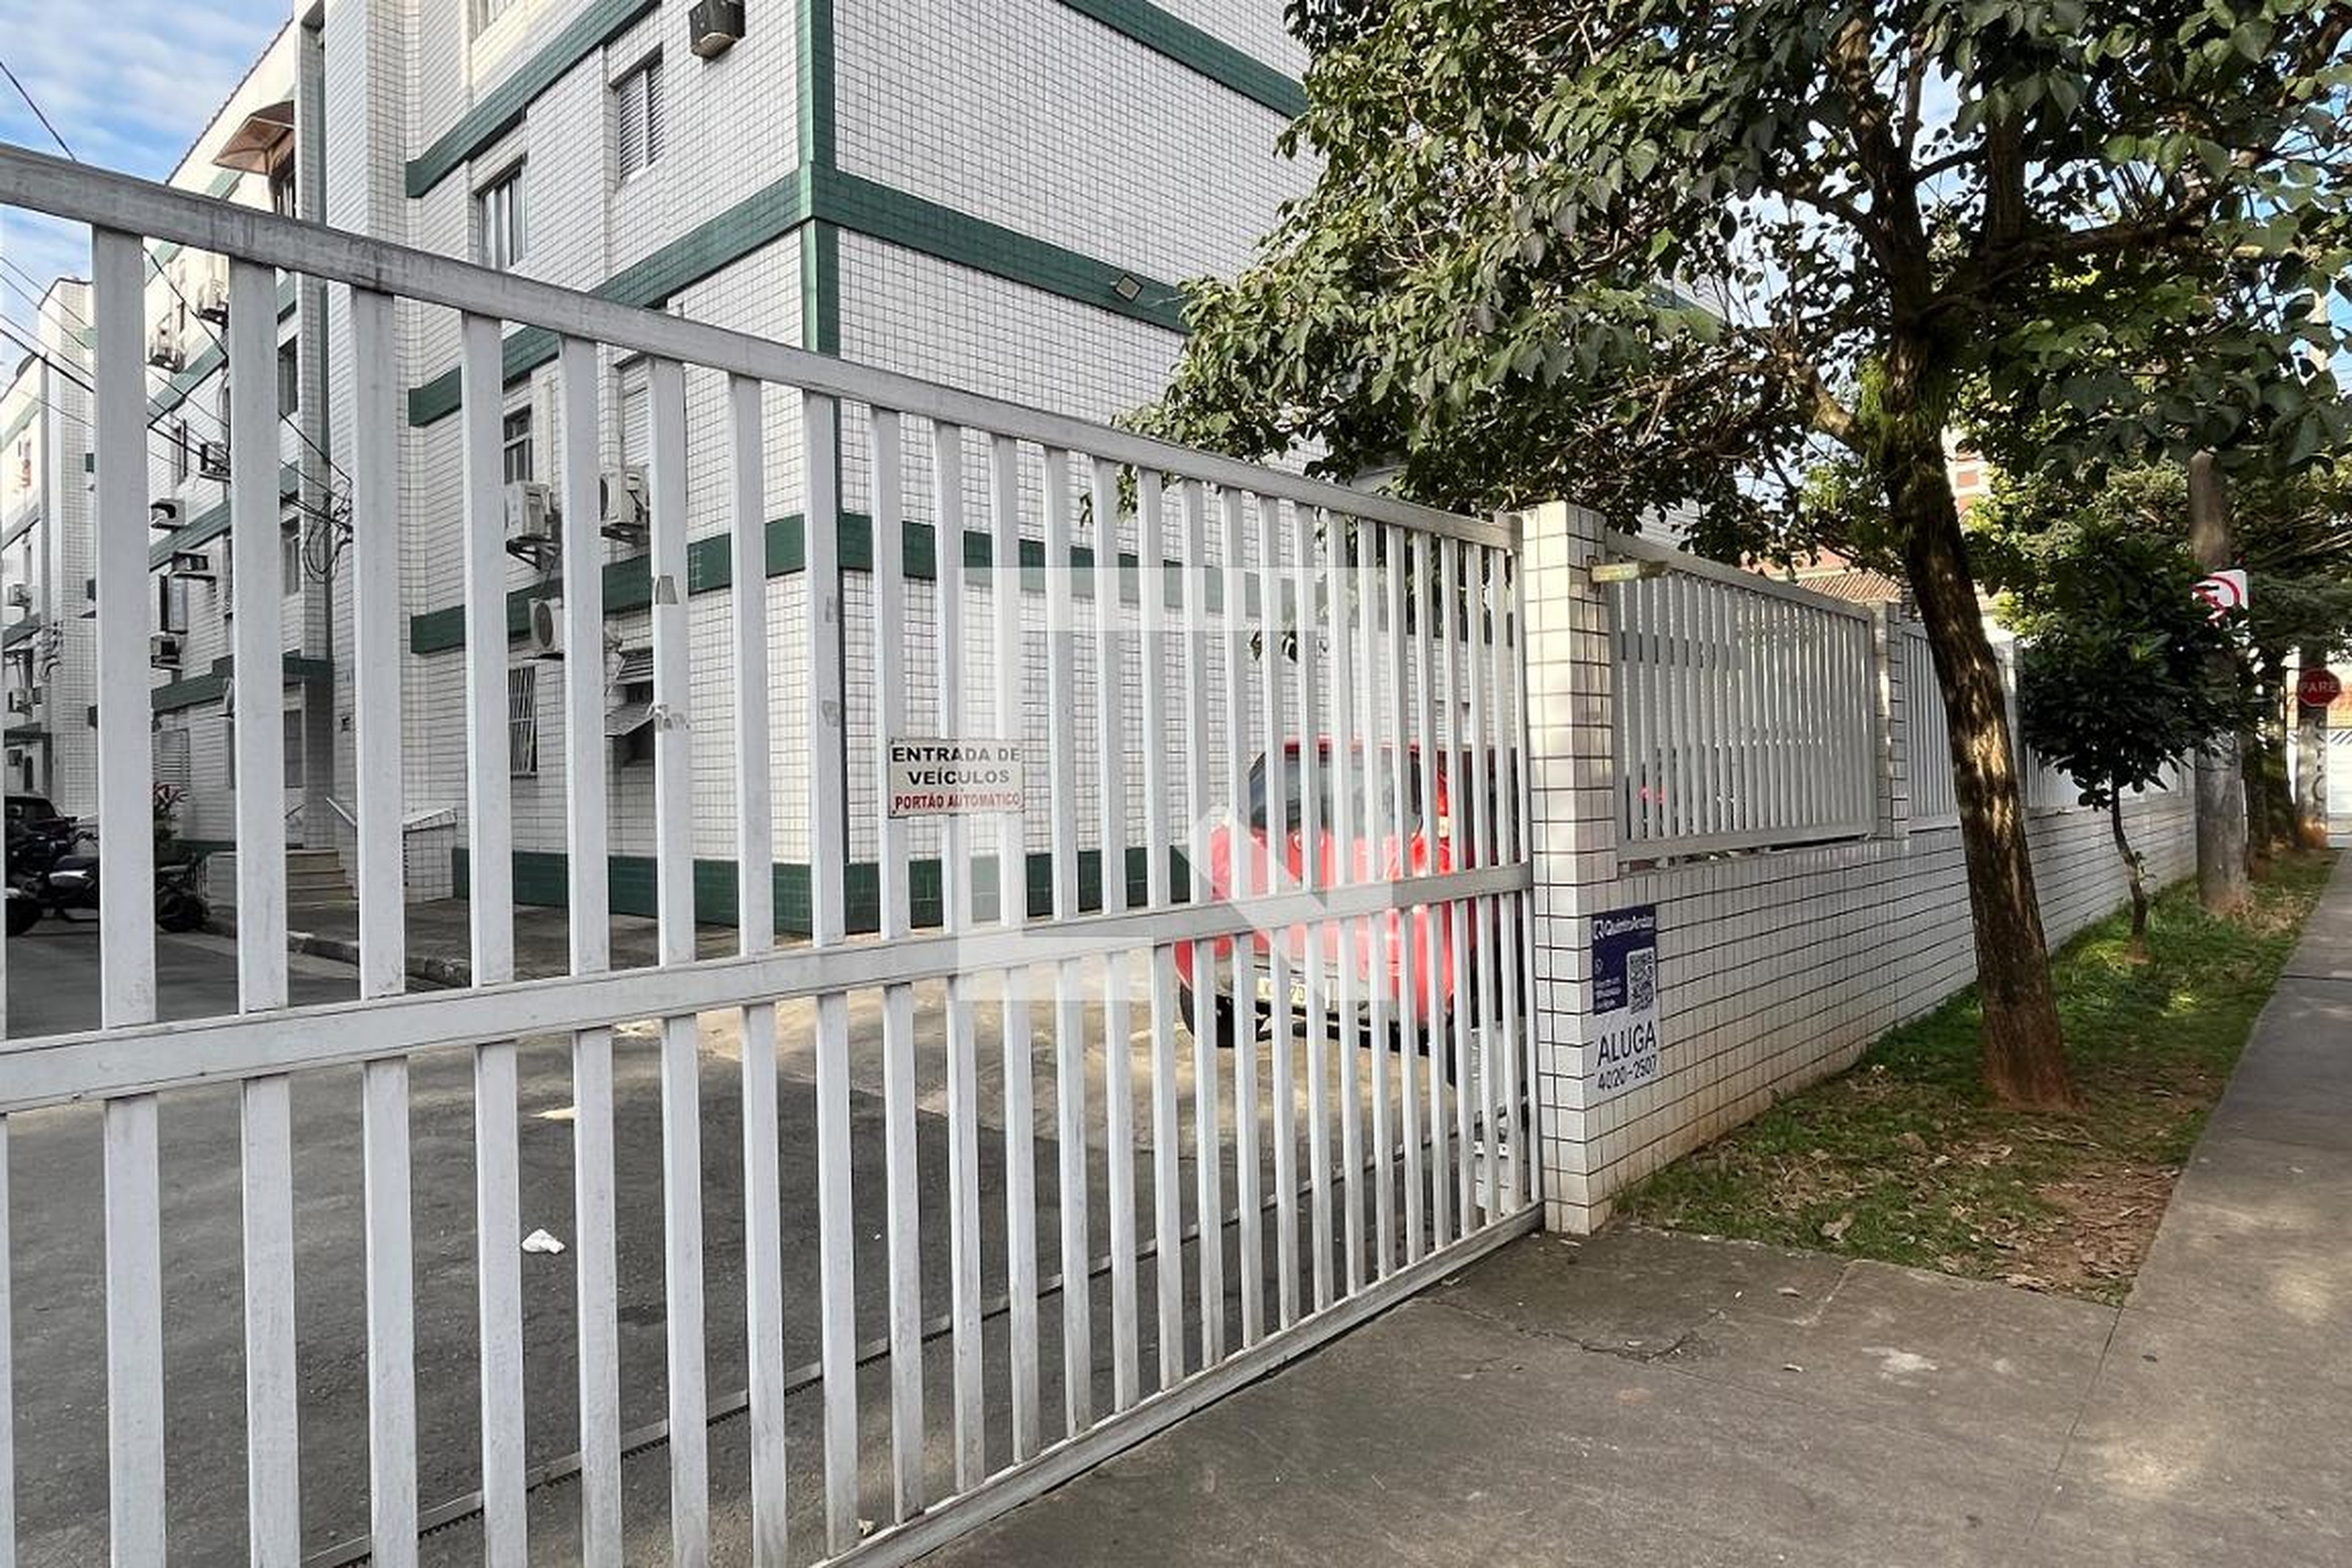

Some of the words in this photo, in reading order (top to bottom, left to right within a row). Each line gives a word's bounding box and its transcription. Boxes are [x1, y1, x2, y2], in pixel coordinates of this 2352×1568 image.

[2299, 680, 2337, 693] PARE
[892, 747, 990, 762] ENTRADA
[998, 747, 1020, 761] DE
[908, 767, 1009, 785] VEÍCULOS
[1597, 1019, 1656, 1066] ALUGA
